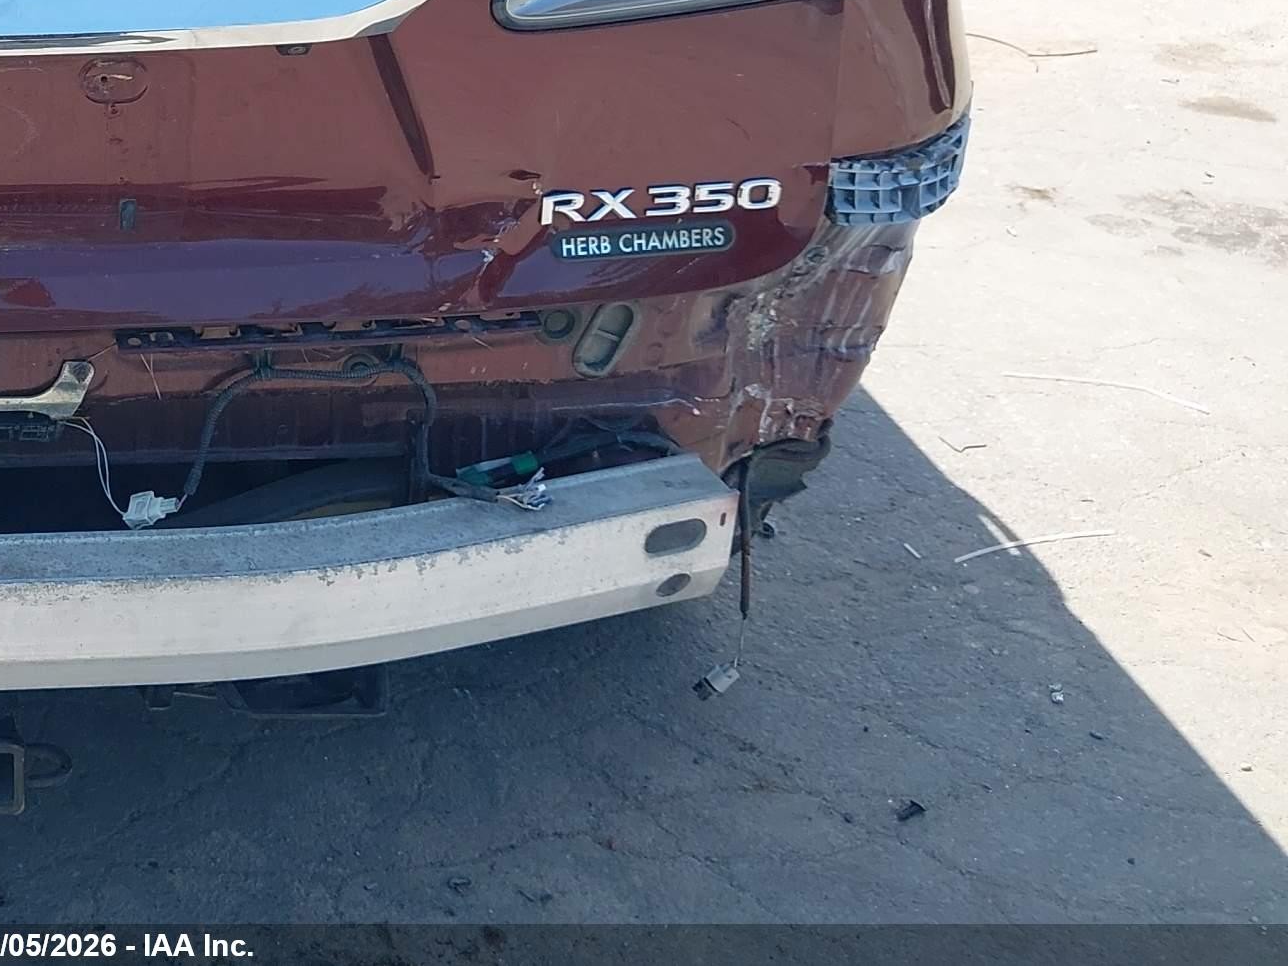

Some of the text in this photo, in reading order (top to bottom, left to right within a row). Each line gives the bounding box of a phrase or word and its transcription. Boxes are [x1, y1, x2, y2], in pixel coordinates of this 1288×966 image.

[540, 177, 782, 226] RX 350
[562, 227, 726, 257] HERB CHAMBERS
